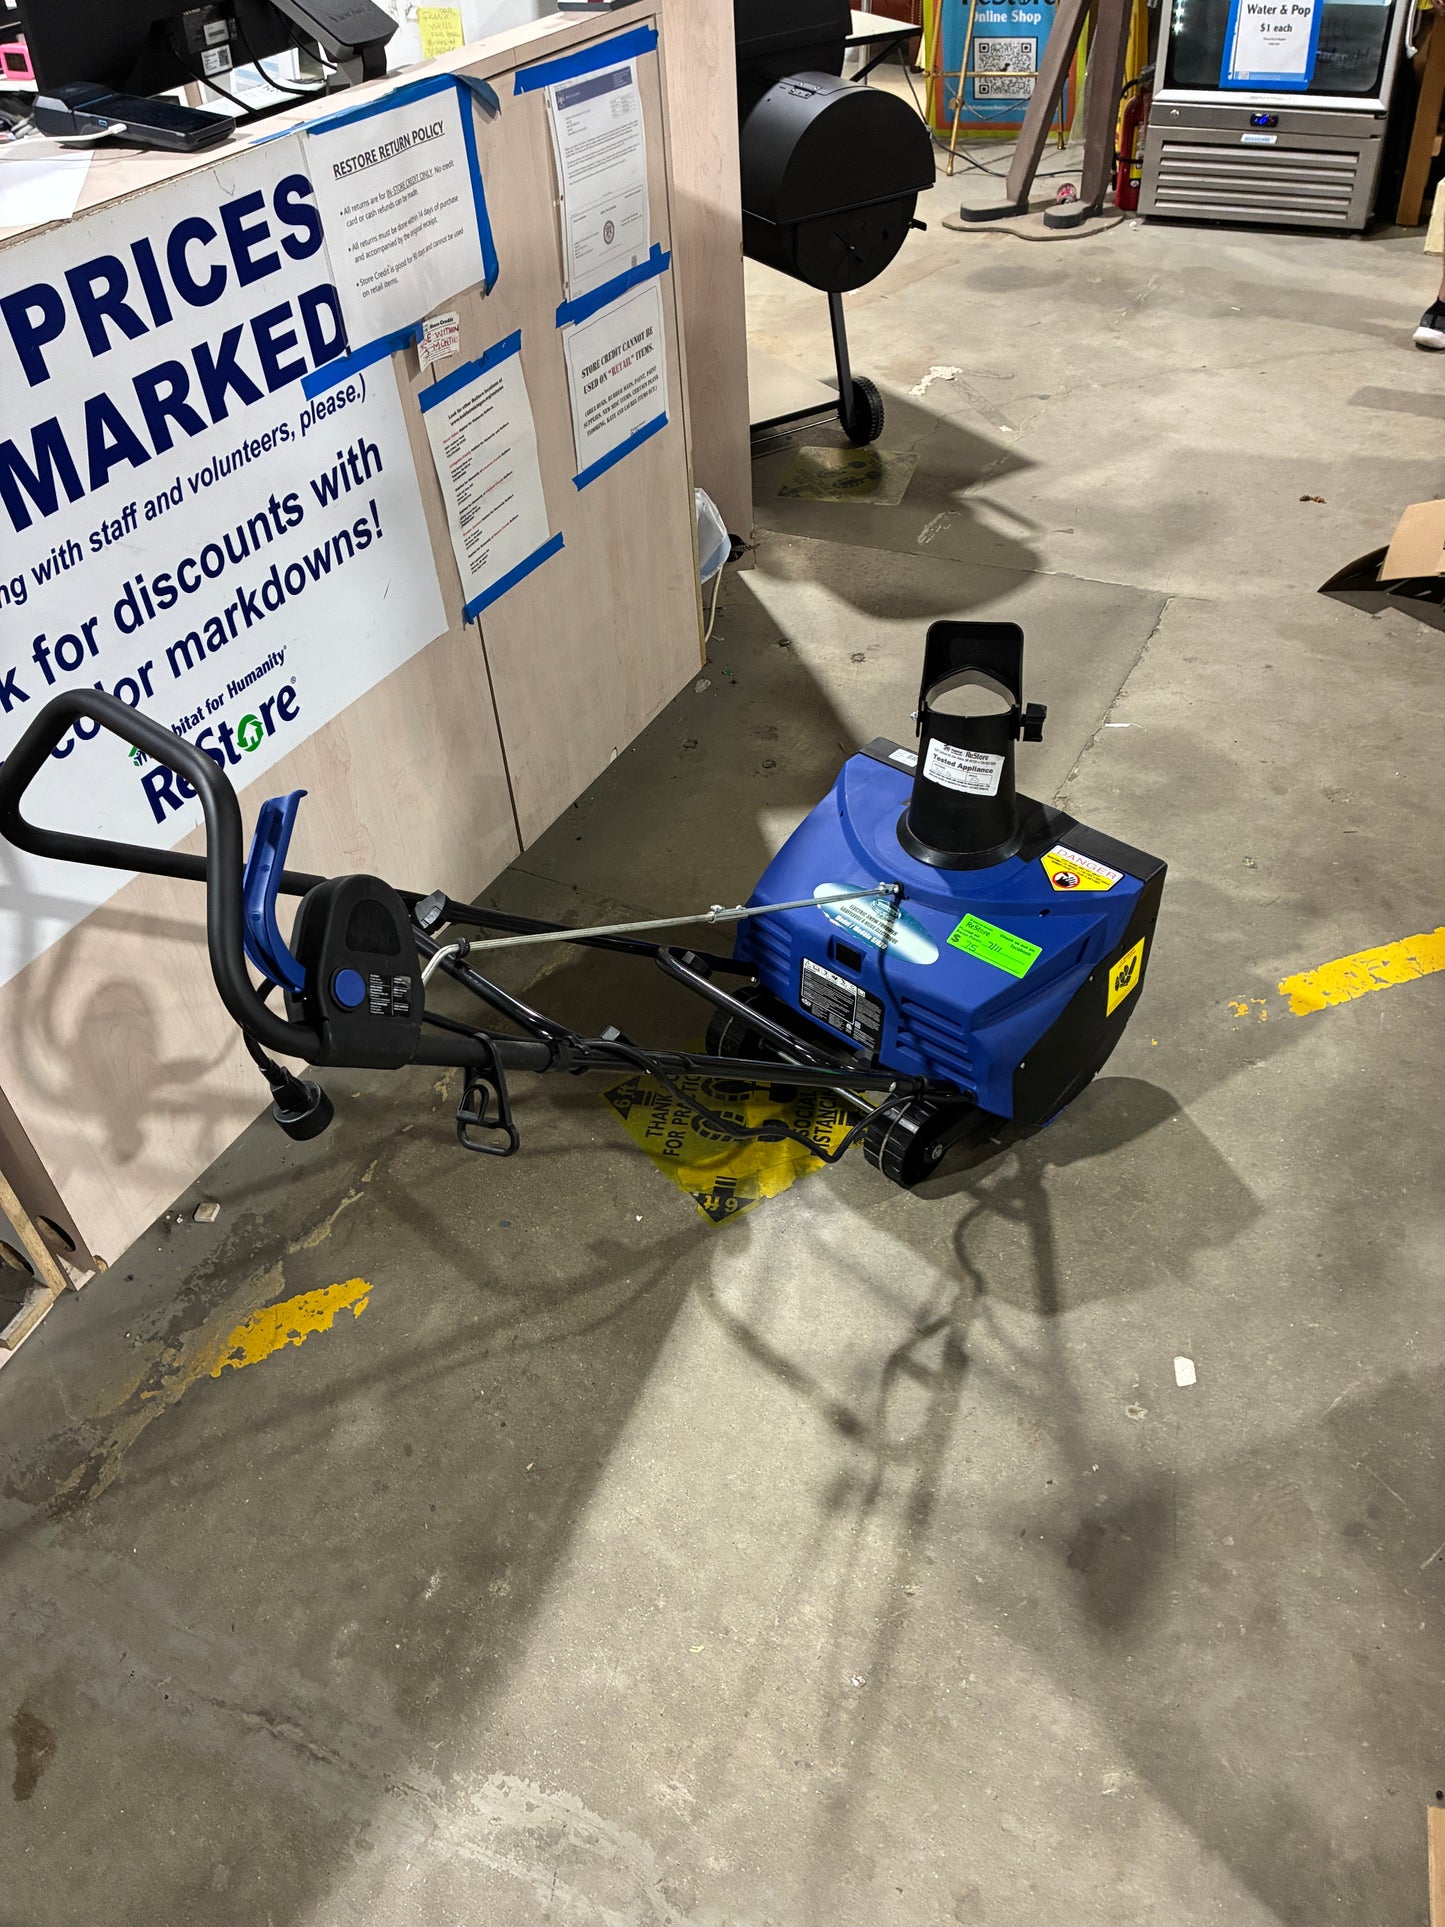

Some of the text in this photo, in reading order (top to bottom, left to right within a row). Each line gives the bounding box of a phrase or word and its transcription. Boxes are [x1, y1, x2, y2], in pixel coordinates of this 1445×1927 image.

[1012, 9, 1042, 25] Shop
[1247, 4, 1311, 17] Water & Pop
[1260, 22, 1293, 32] $1 each
[333, 120, 445, 178] RESTORE RETURN POLICY
[343, 205, 352, 215] All
[351, 199, 370, 212] returns
[370, 196, 378, 205] are
[378, 192, 386, 201] for
[405, 173, 419, 188] CREDIT
[434, 165, 441, 174] No
[442, 160, 455, 171] credit
[346, 216, 358, 228] card
[365, 208, 378, 220] cash
[377, 201, 395, 216] refunds
[395, 197, 403, 207] can
[360, 234, 378, 250] returns
[378, 228, 391, 240] must
[391, 226, 398, 234] be
[397, 220, 408, 231] done
[423, 205, 434, 217] days
[433, 202, 440, 211] of
[439, 195, 458, 210] purchase
[354, 252, 365, 263] and
[365, 238, 398, 259] accompanied
[397, 236, 404, 246] by
[403, 232, 411, 242] the
[359, 275, 374, 287] Store
[373, 265, 390, 280] Credit
[394, 259, 408, 272] good
[425, 242, 433, 252] and
[433, 235, 448, 250] cannot
[447, 232, 454, 240] be
[453, 226, 464, 238] used
[0, 173, 325, 388] PRICES
[362, 288, 370, 298] on
[370, 282, 384, 294] retail
[440, 317, 454, 326] Credit
[581, 325, 654, 379] STORE CREDIT CANNOT BE
[583, 376, 600, 395] USED
[599, 371, 608, 384] ON
[0, 283, 349, 533] MARKED
[30, 374, 367, 586] with staff and volunteers, please.)
[32, 616, 99, 686] for
[113, 492, 305, 635] discounts
[309, 437, 384, 508] with
[164, 499, 385, 680] markdowns!
[205, 693, 224, 715] for
[932, 753, 956, 768] Tested
[957, 762, 994, 774] Appliance
[965, 750, 989, 761] ReStore
[1055, 848, 1118, 881] DANGER
[951, 933, 962, 943] $
[966, 921, 991, 937] ReStore
[1000, 933, 1014, 943] Check
[1009, 944, 1033, 957] facebook
[645, 1087, 673, 1138] THANK
[662, 1131, 687, 1157] FOR
[725, 1199, 739, 1213] 6
